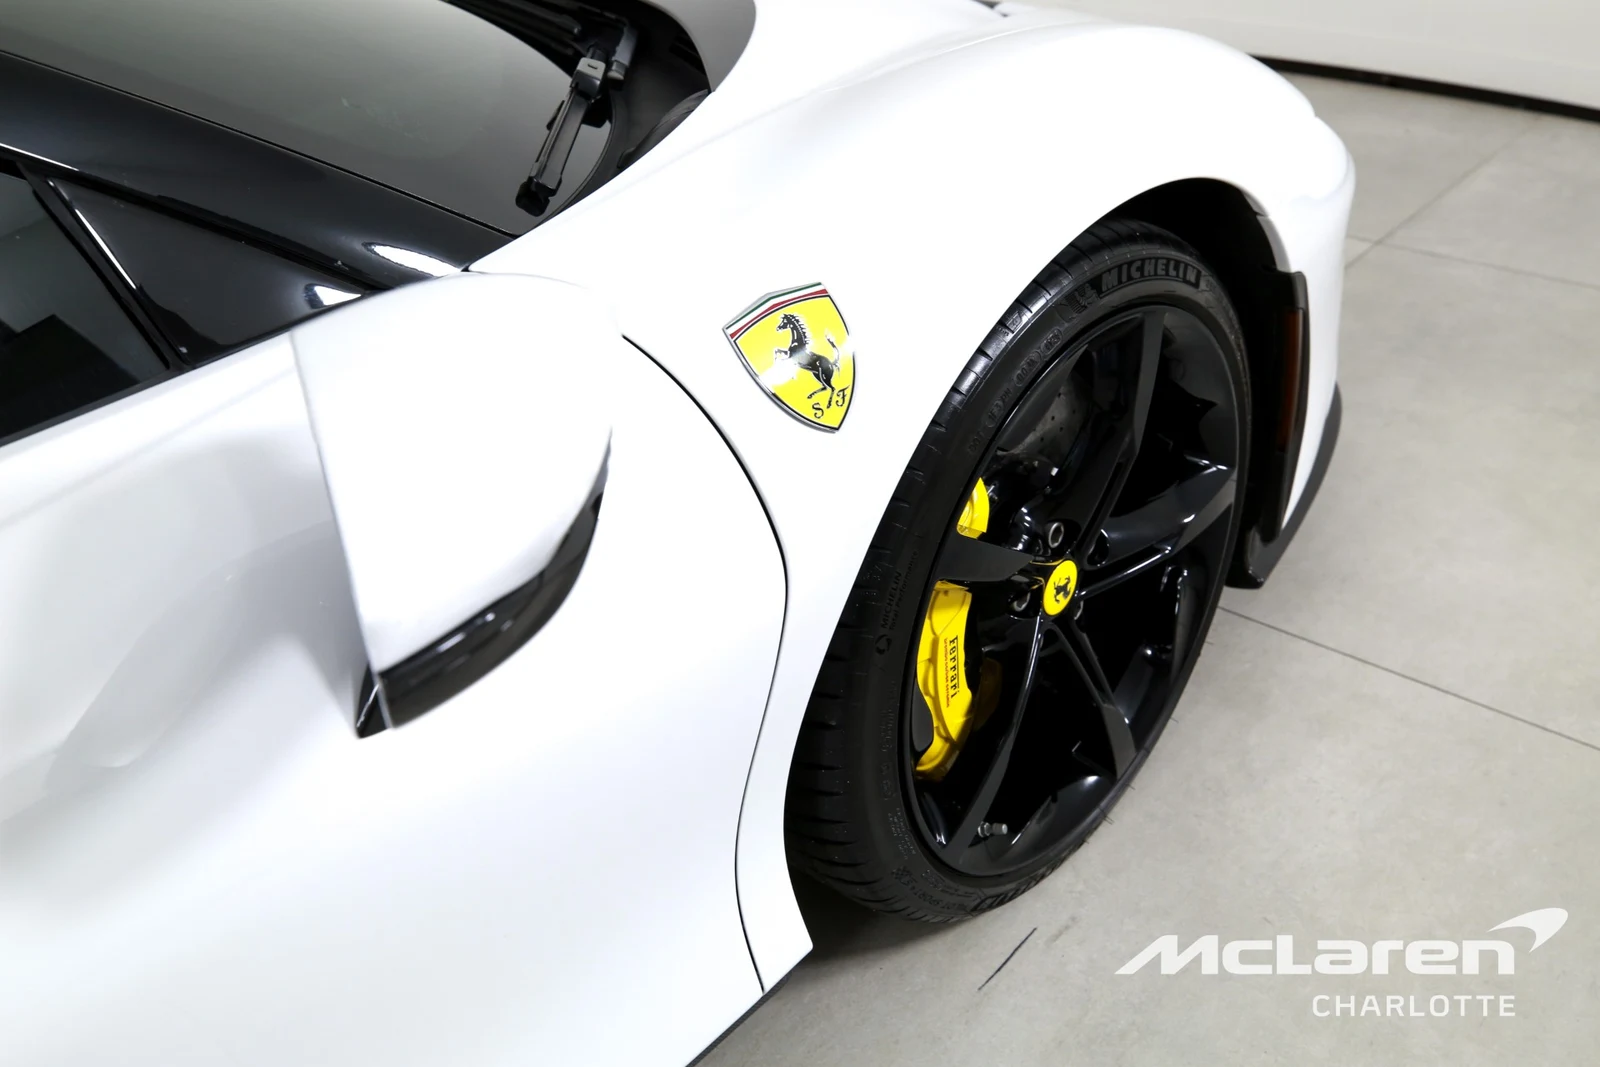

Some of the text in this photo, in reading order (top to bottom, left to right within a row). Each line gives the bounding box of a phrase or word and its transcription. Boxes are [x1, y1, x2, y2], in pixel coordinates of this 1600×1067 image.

[1102, 259, 1198, 292] MICHELIN
[811, 385, 850, 419] S F
[881, 571, 902, 628] MICHELIN
[949, 634, 960, 699] Ferrari
